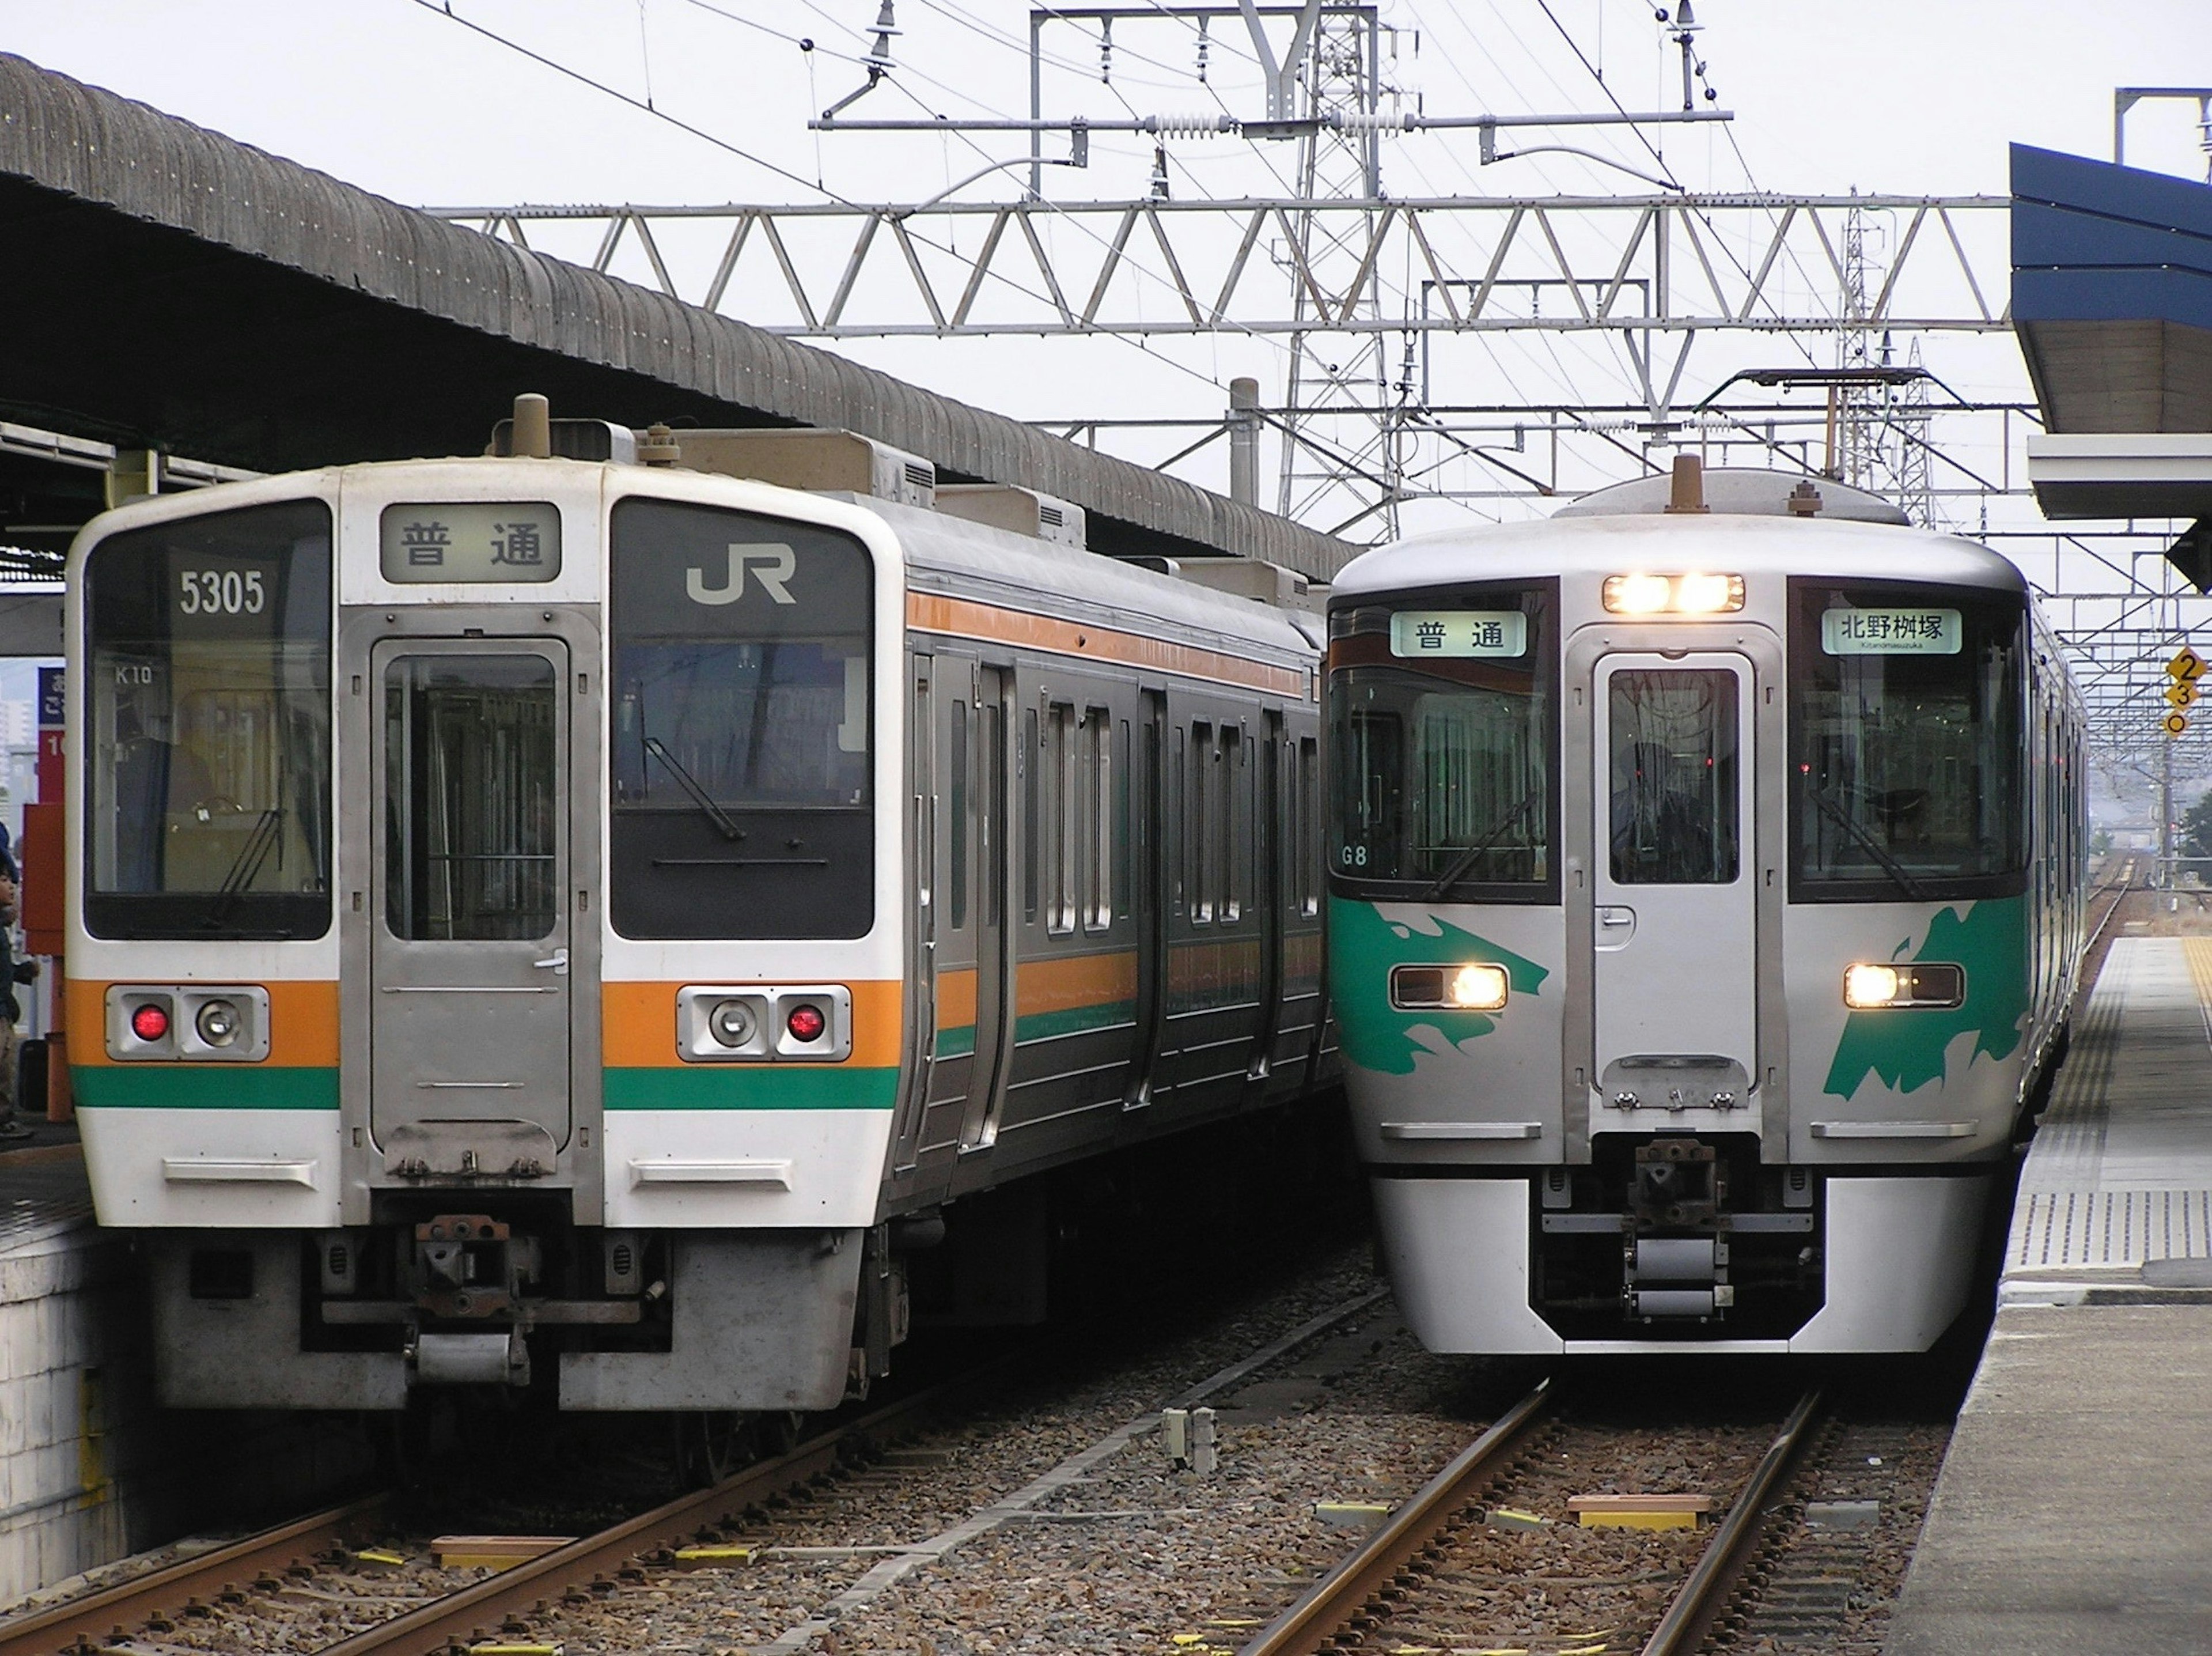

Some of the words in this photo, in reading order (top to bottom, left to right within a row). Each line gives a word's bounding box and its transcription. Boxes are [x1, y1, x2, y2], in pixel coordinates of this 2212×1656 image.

[402, 522, 543, 565] 普通
[687, 543, 797, 605] JR
[180, 570, 264, 614] 5305
[1416, 622, 1504, 648] 普通
[1842, 615, 1943, 639] 北野桝塚
[116, 666, 151, 684] K10
[2181, 655, 2196, 680] 2
[2177, 685, 2190, 705] 3
[1342, 845, 1367, 865] G8
